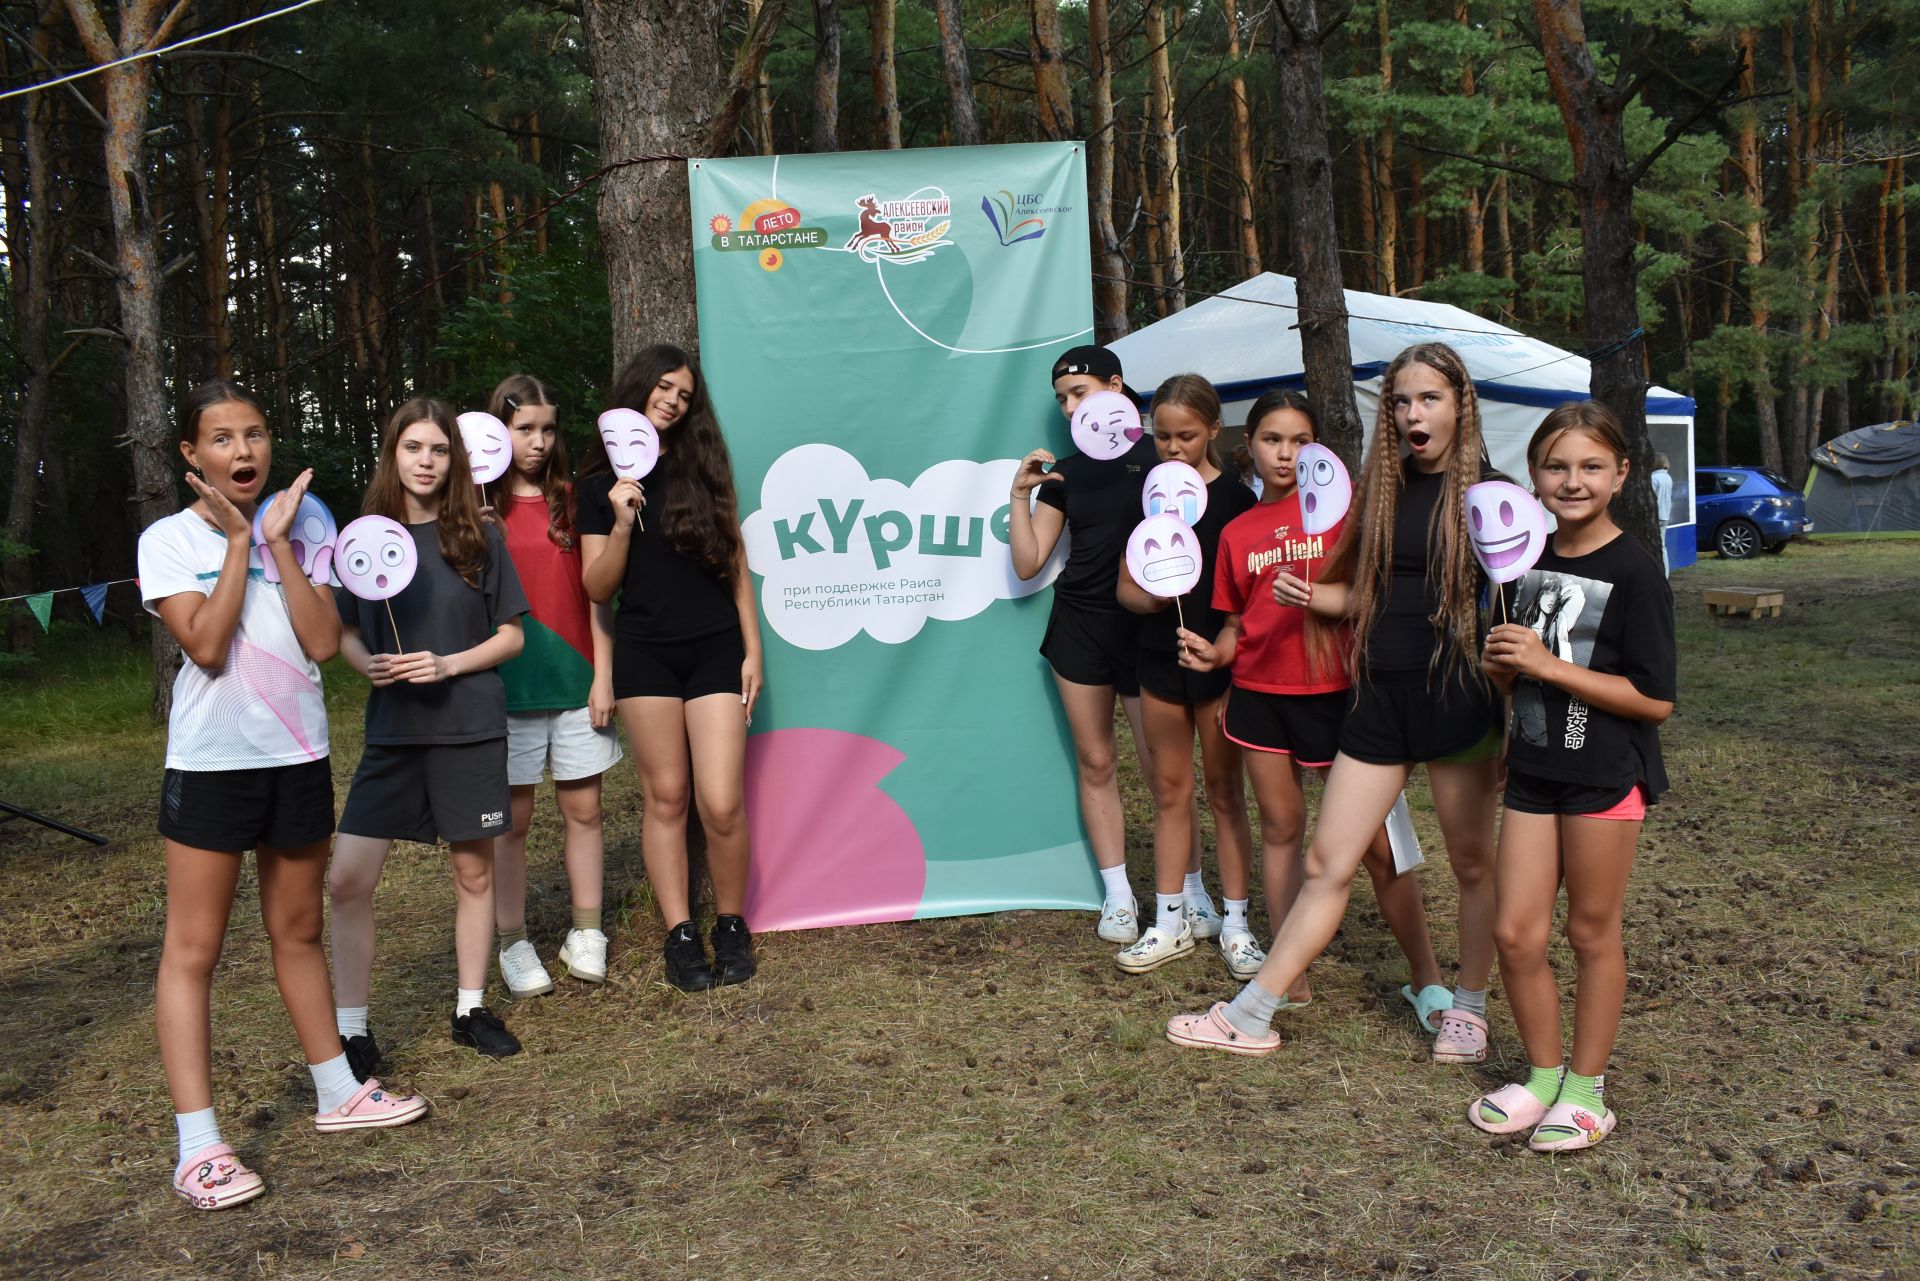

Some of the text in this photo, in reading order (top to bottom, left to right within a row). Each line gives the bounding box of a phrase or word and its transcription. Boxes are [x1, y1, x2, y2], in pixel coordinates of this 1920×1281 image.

[883, 198, 949, 218] АЛЕКСЕЕВСКИЙ
[1017, 193, 1044, 206] ЦБС
[762, 212, 794, 231] ЛЕТО
[893, 220, 923, 238] район
[721, 232, 818, 247] В ТАТАРСТАНЕ
[1248, 547, 1282, 575] Open
[784, 577, 942, 598] при поддержке Раиса
[784, 591, 945, 611] Республики Татарстан
[481, 811, 503, 822] PUSH
